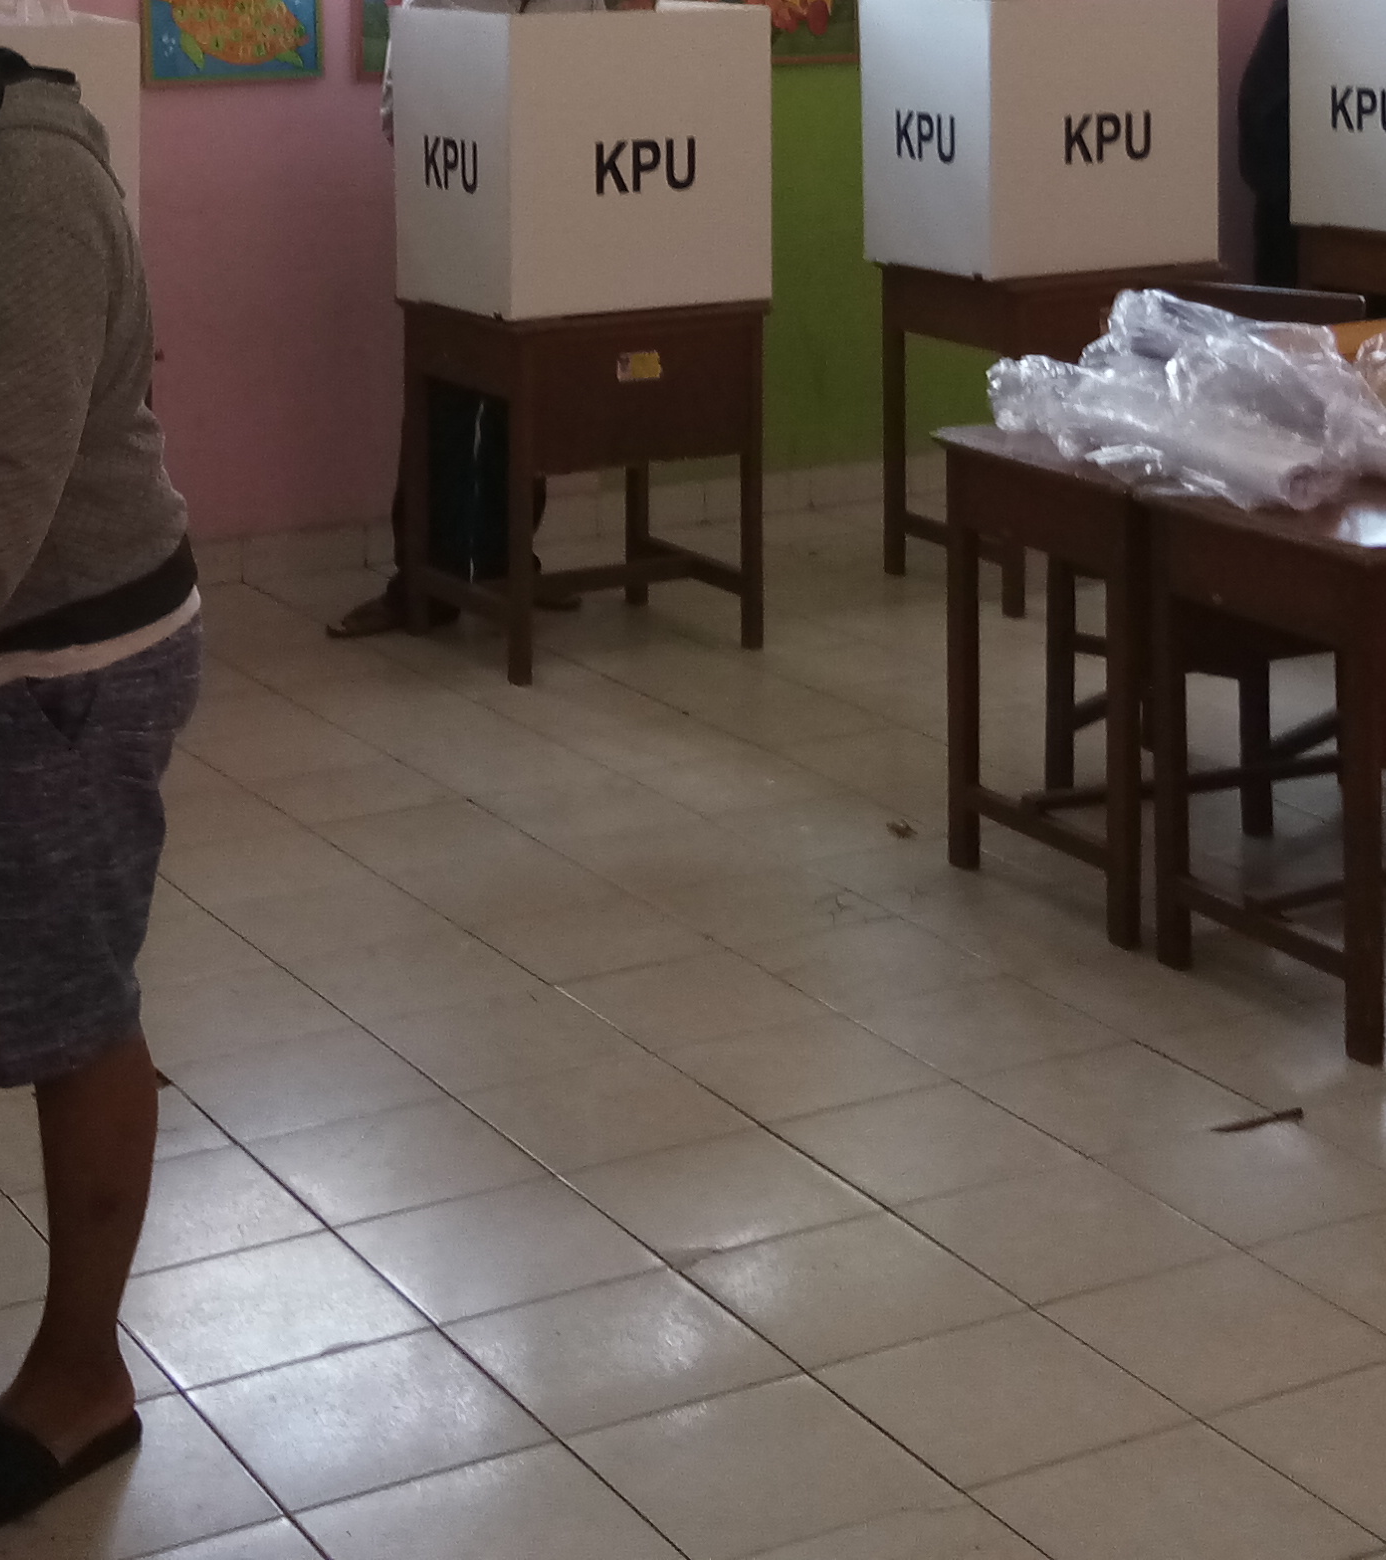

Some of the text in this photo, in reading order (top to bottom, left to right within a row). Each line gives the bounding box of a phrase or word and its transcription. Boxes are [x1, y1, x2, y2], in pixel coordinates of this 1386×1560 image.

[423, 134, 478, 195] KPU
[595, 136, 696, 196] KPU
[895, 110, 956, 165] KPU
[1064, 110, 1152, 165] KPU
